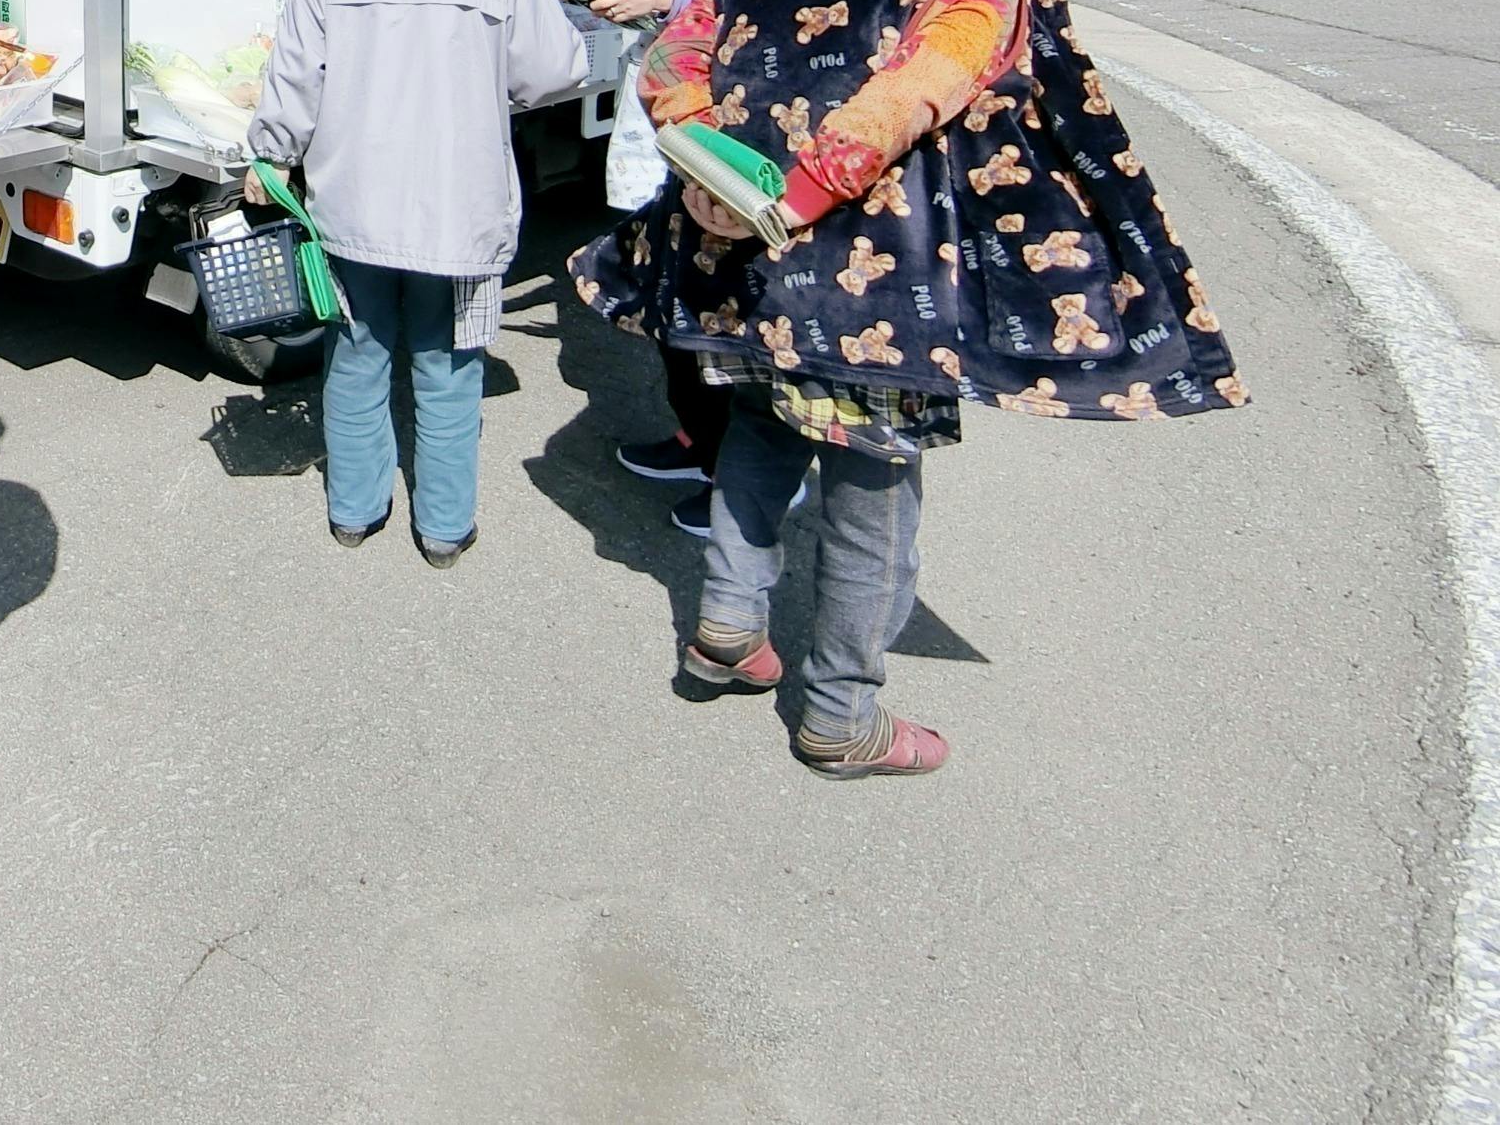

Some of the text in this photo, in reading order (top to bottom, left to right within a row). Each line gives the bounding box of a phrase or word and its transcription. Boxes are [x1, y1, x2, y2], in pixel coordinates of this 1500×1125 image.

[763, 47, 778, 79] POLO
[809, 52, 845, 70] POLO
[1072, 151, 1106, 180] POLO
[784, 270, 816, 289] POLO
[911, 285, 937, 320] POLO
[805, 319, 830, 353] POLO
[1006, 315, 1033, 353] POLO
[1129, 323, 1170, 354] POLO
[1167, 370, 1203, 405] POLO
